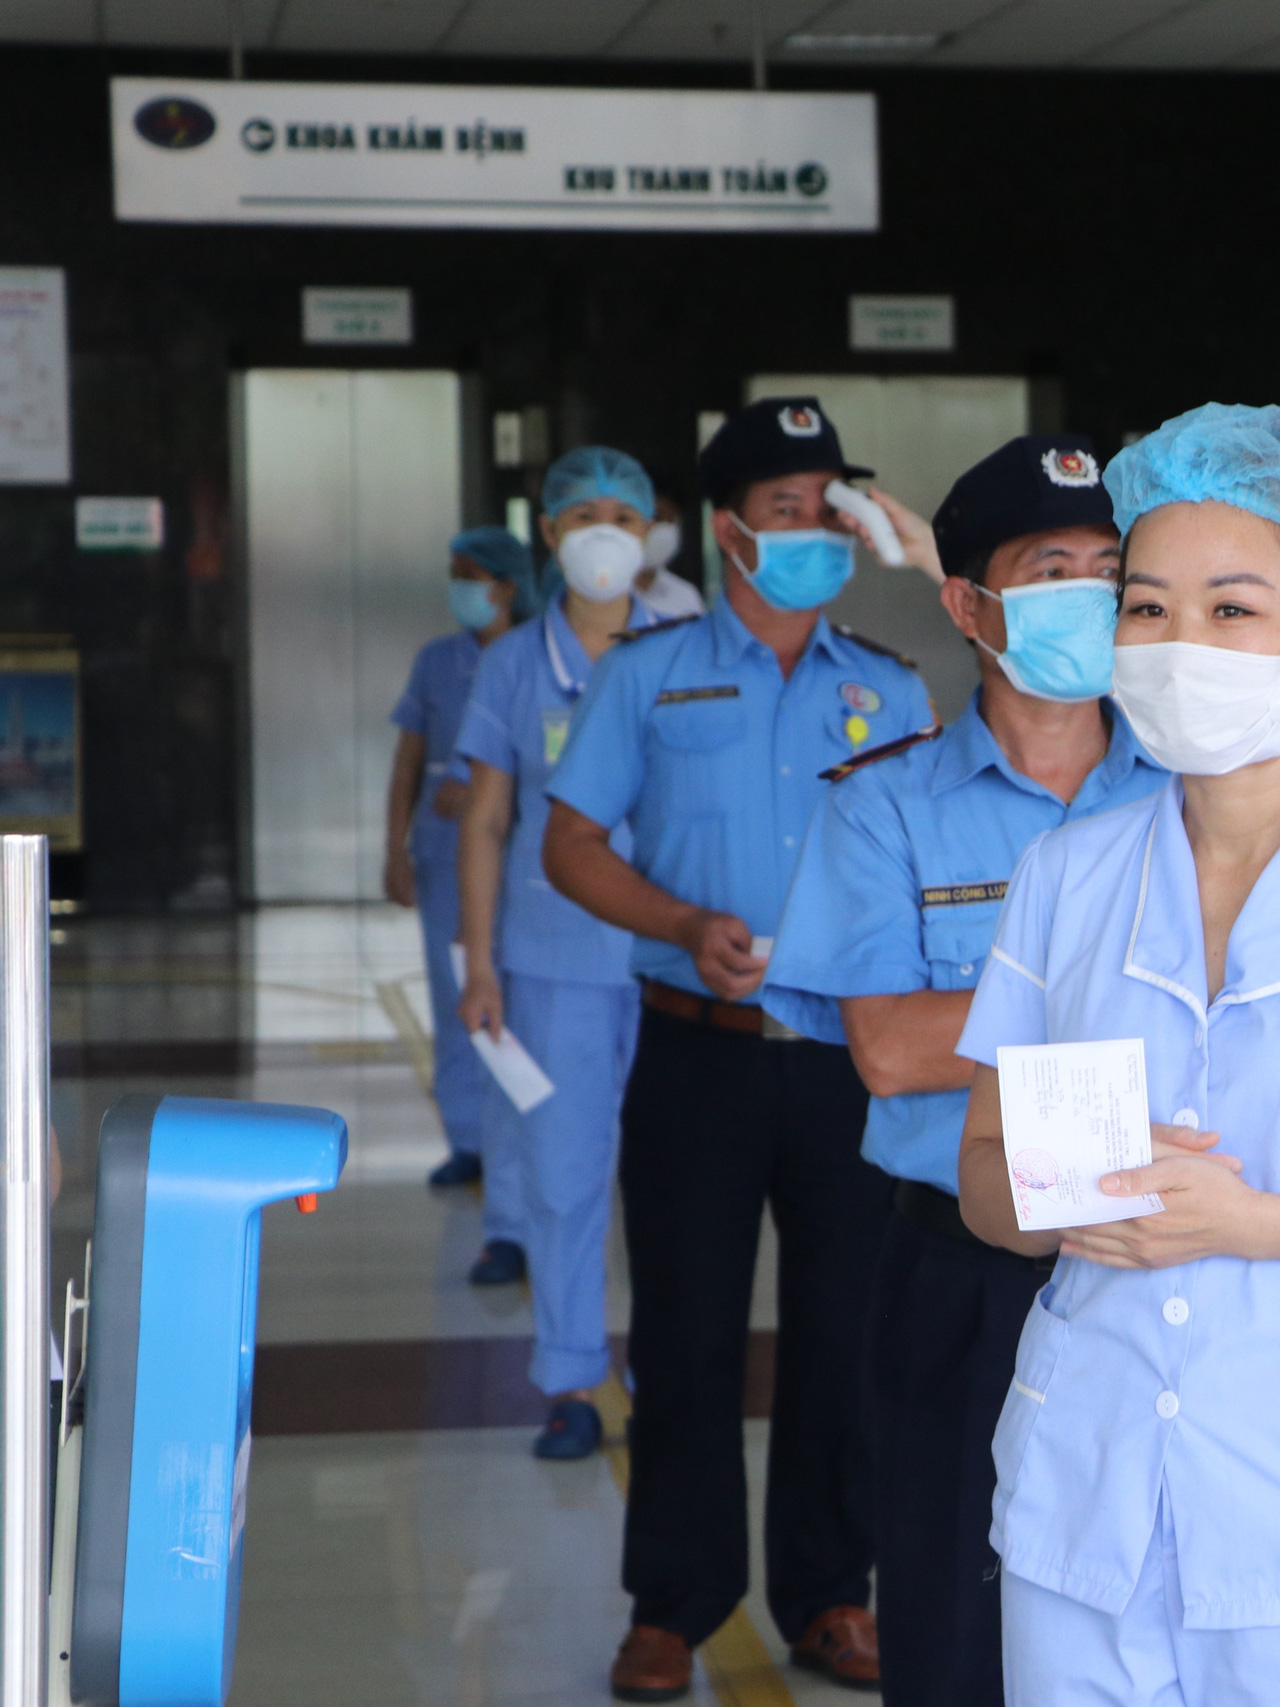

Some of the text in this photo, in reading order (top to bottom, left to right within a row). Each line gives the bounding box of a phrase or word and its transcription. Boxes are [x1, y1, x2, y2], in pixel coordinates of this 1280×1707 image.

[286, 121, 356, 149] KHOA
[367, 116, 444, 150] KHÁM
[564, 166, 614, 192] KHU
[627, 165, 711, 193] THANH
